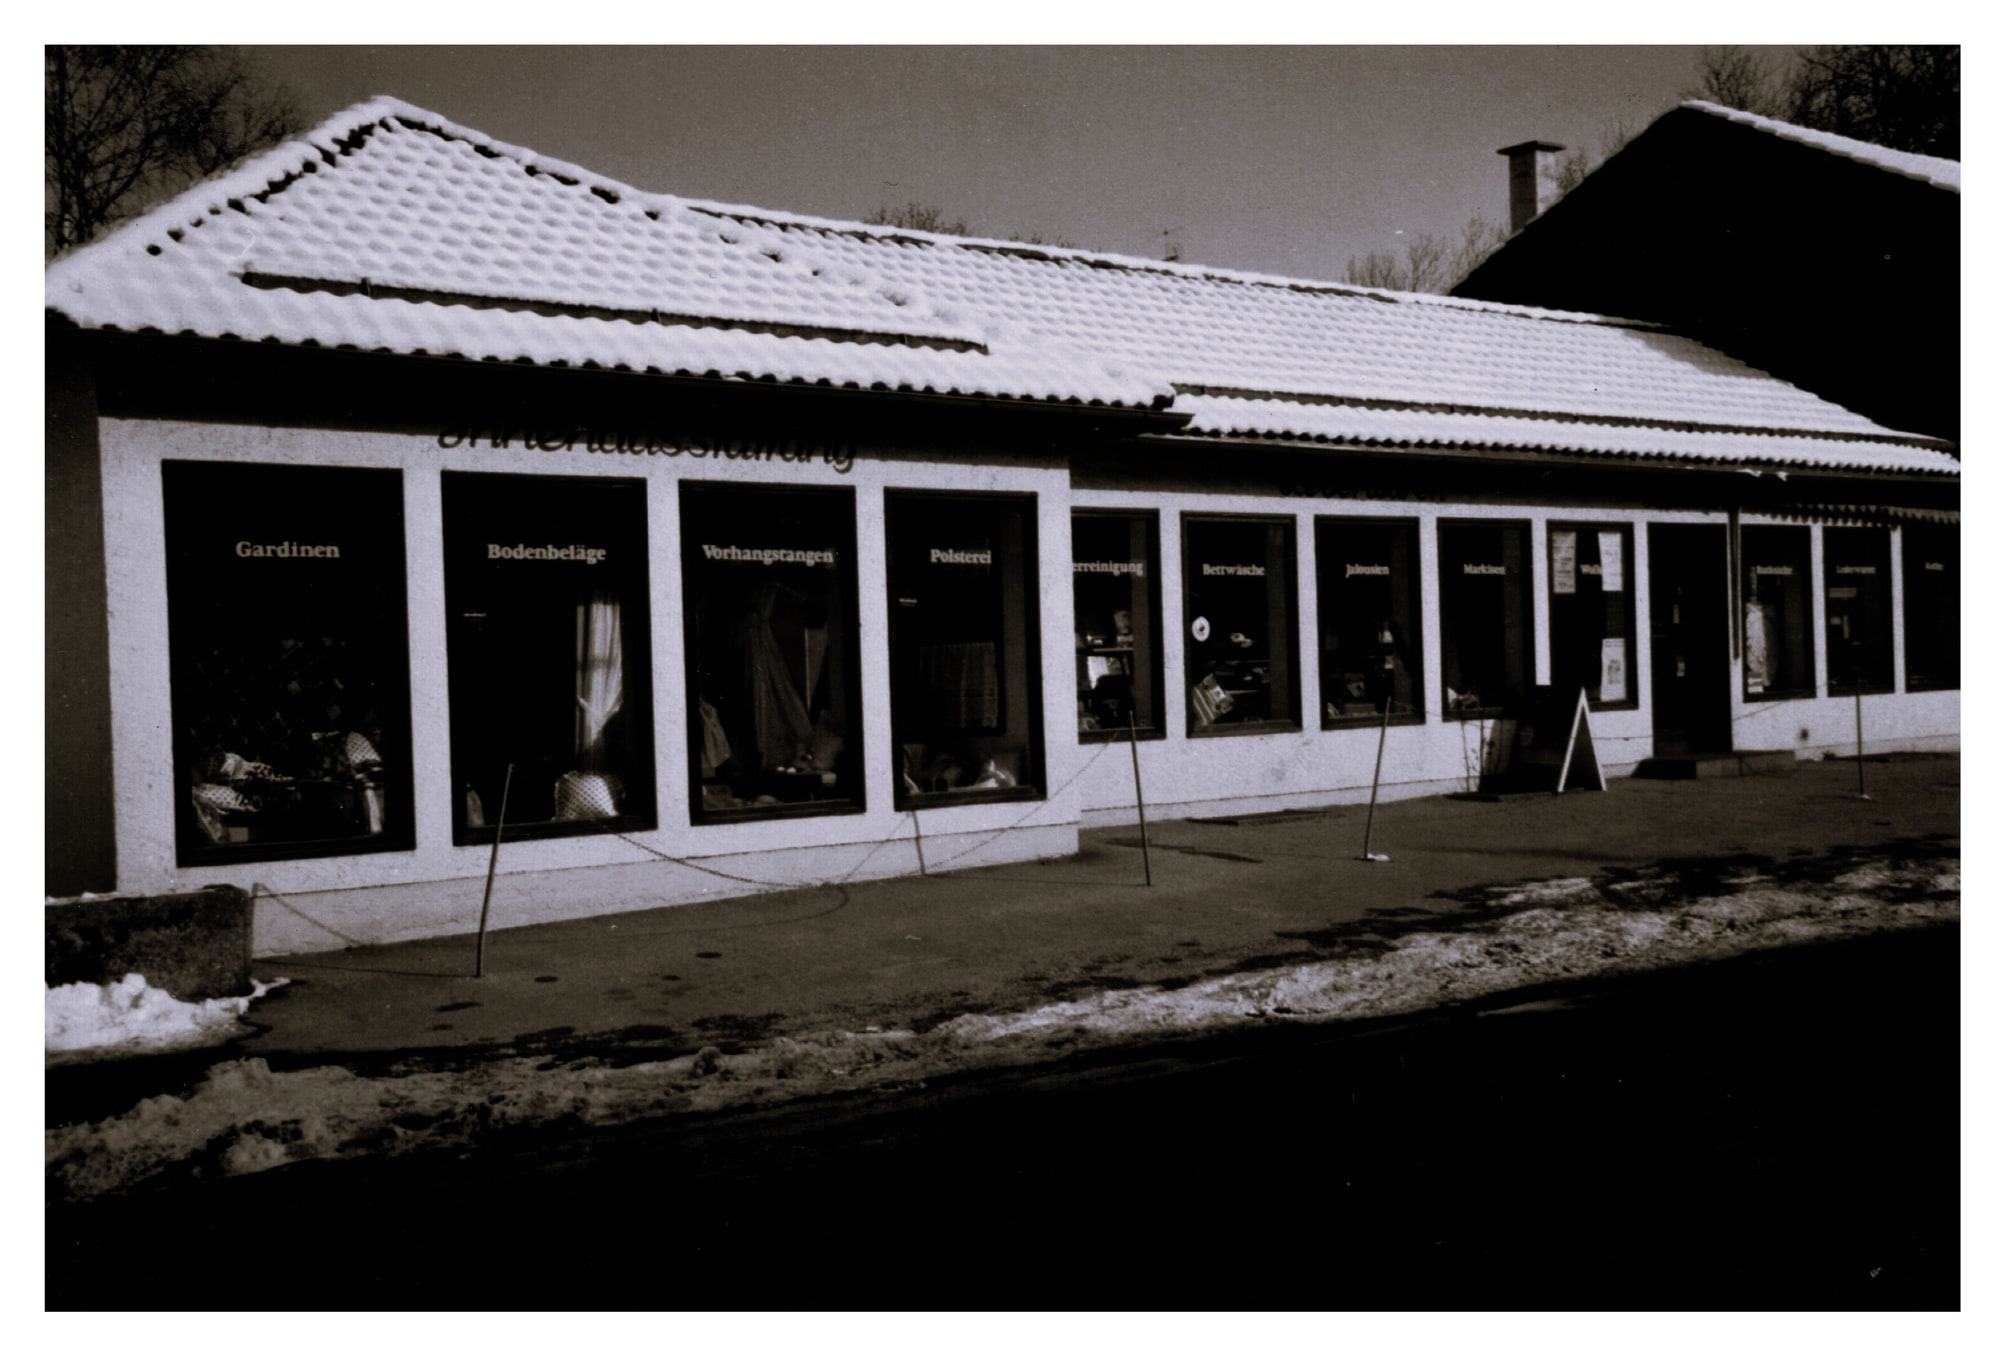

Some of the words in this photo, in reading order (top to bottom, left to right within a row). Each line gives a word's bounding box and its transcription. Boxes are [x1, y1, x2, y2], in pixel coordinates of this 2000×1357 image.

[235, 540, 340, 559] Gardinen
[486, 543, 607, 564] Bodenbeläge
[702, 543, 835, 567] Vorhangstangen
[930, 547, 992, 565] Polsterei
[1202, 562, 1266, 577] Bettwäsche
[1345, 562, 1390, 578] Jalousien
[1463, 562, 1507, 576] Markisen
